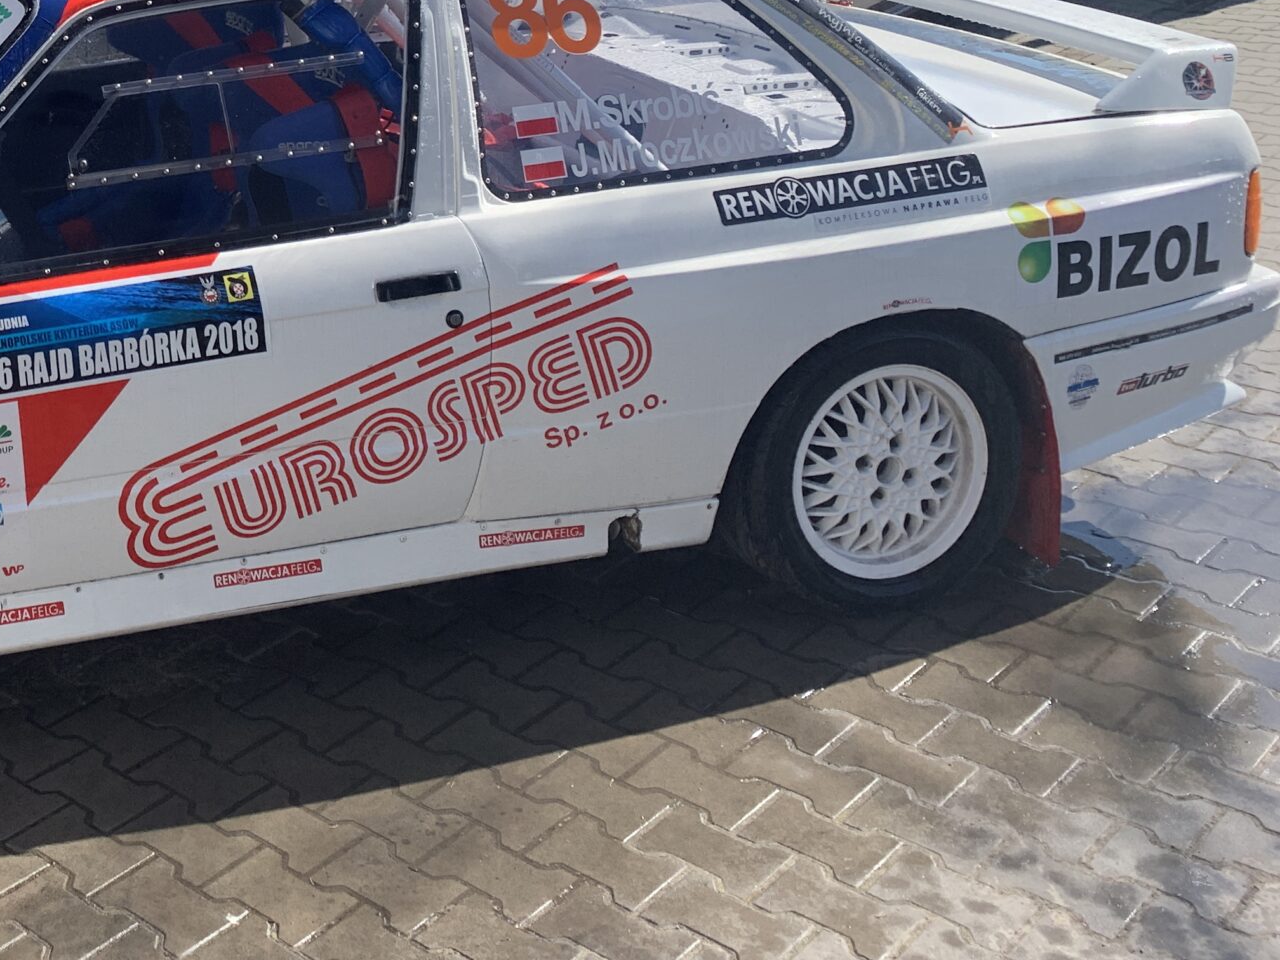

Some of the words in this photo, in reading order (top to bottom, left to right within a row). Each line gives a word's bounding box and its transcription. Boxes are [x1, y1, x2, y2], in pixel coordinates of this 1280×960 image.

[818, 7, 864, 45] myjnia
[556, 81, 720, 133] M.Skrobić
[570, 112, 803, 178] J.Mroczkowski
[818, 207, 899, 225] KOMPLEKSOWA
[902, 197, 961, 213] NAPRAWA
[963, 192, 989, 205] FELG
[1057, 222, 1220, 298] BIZOL
[18, 346, 75, 388] RAJD
[78, 327, 202, 378] BARBÓRKA
[204, 316, 261, 357] 2018
[118, 316, 653, 569] EUROSPED
[544, 424, 589, 450] Sp.
[598, 412, 613, 430] z
[618, 392, 669, 419] o.o.
